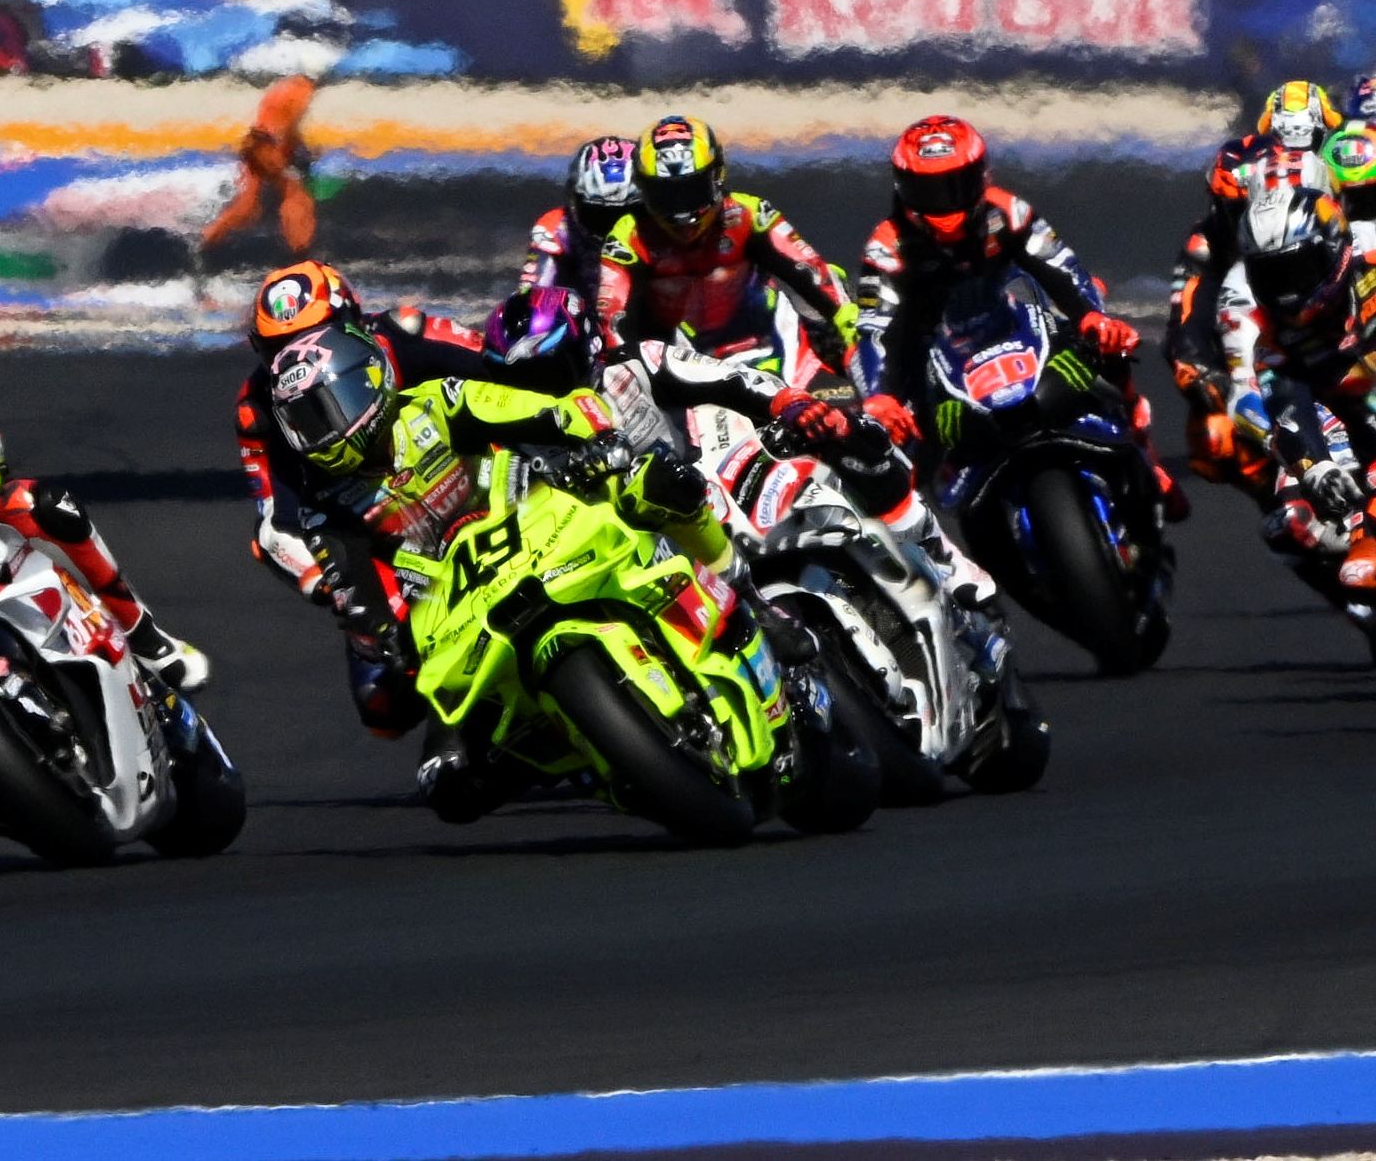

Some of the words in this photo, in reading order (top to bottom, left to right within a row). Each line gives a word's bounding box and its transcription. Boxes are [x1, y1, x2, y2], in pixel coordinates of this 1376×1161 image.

[279, 368, 308, 391] SHOEI
[963, 347, 1039, 402] 20
[545, 504, 578, 548] PERTAMINA
[448, 511, 523, 613] 49
